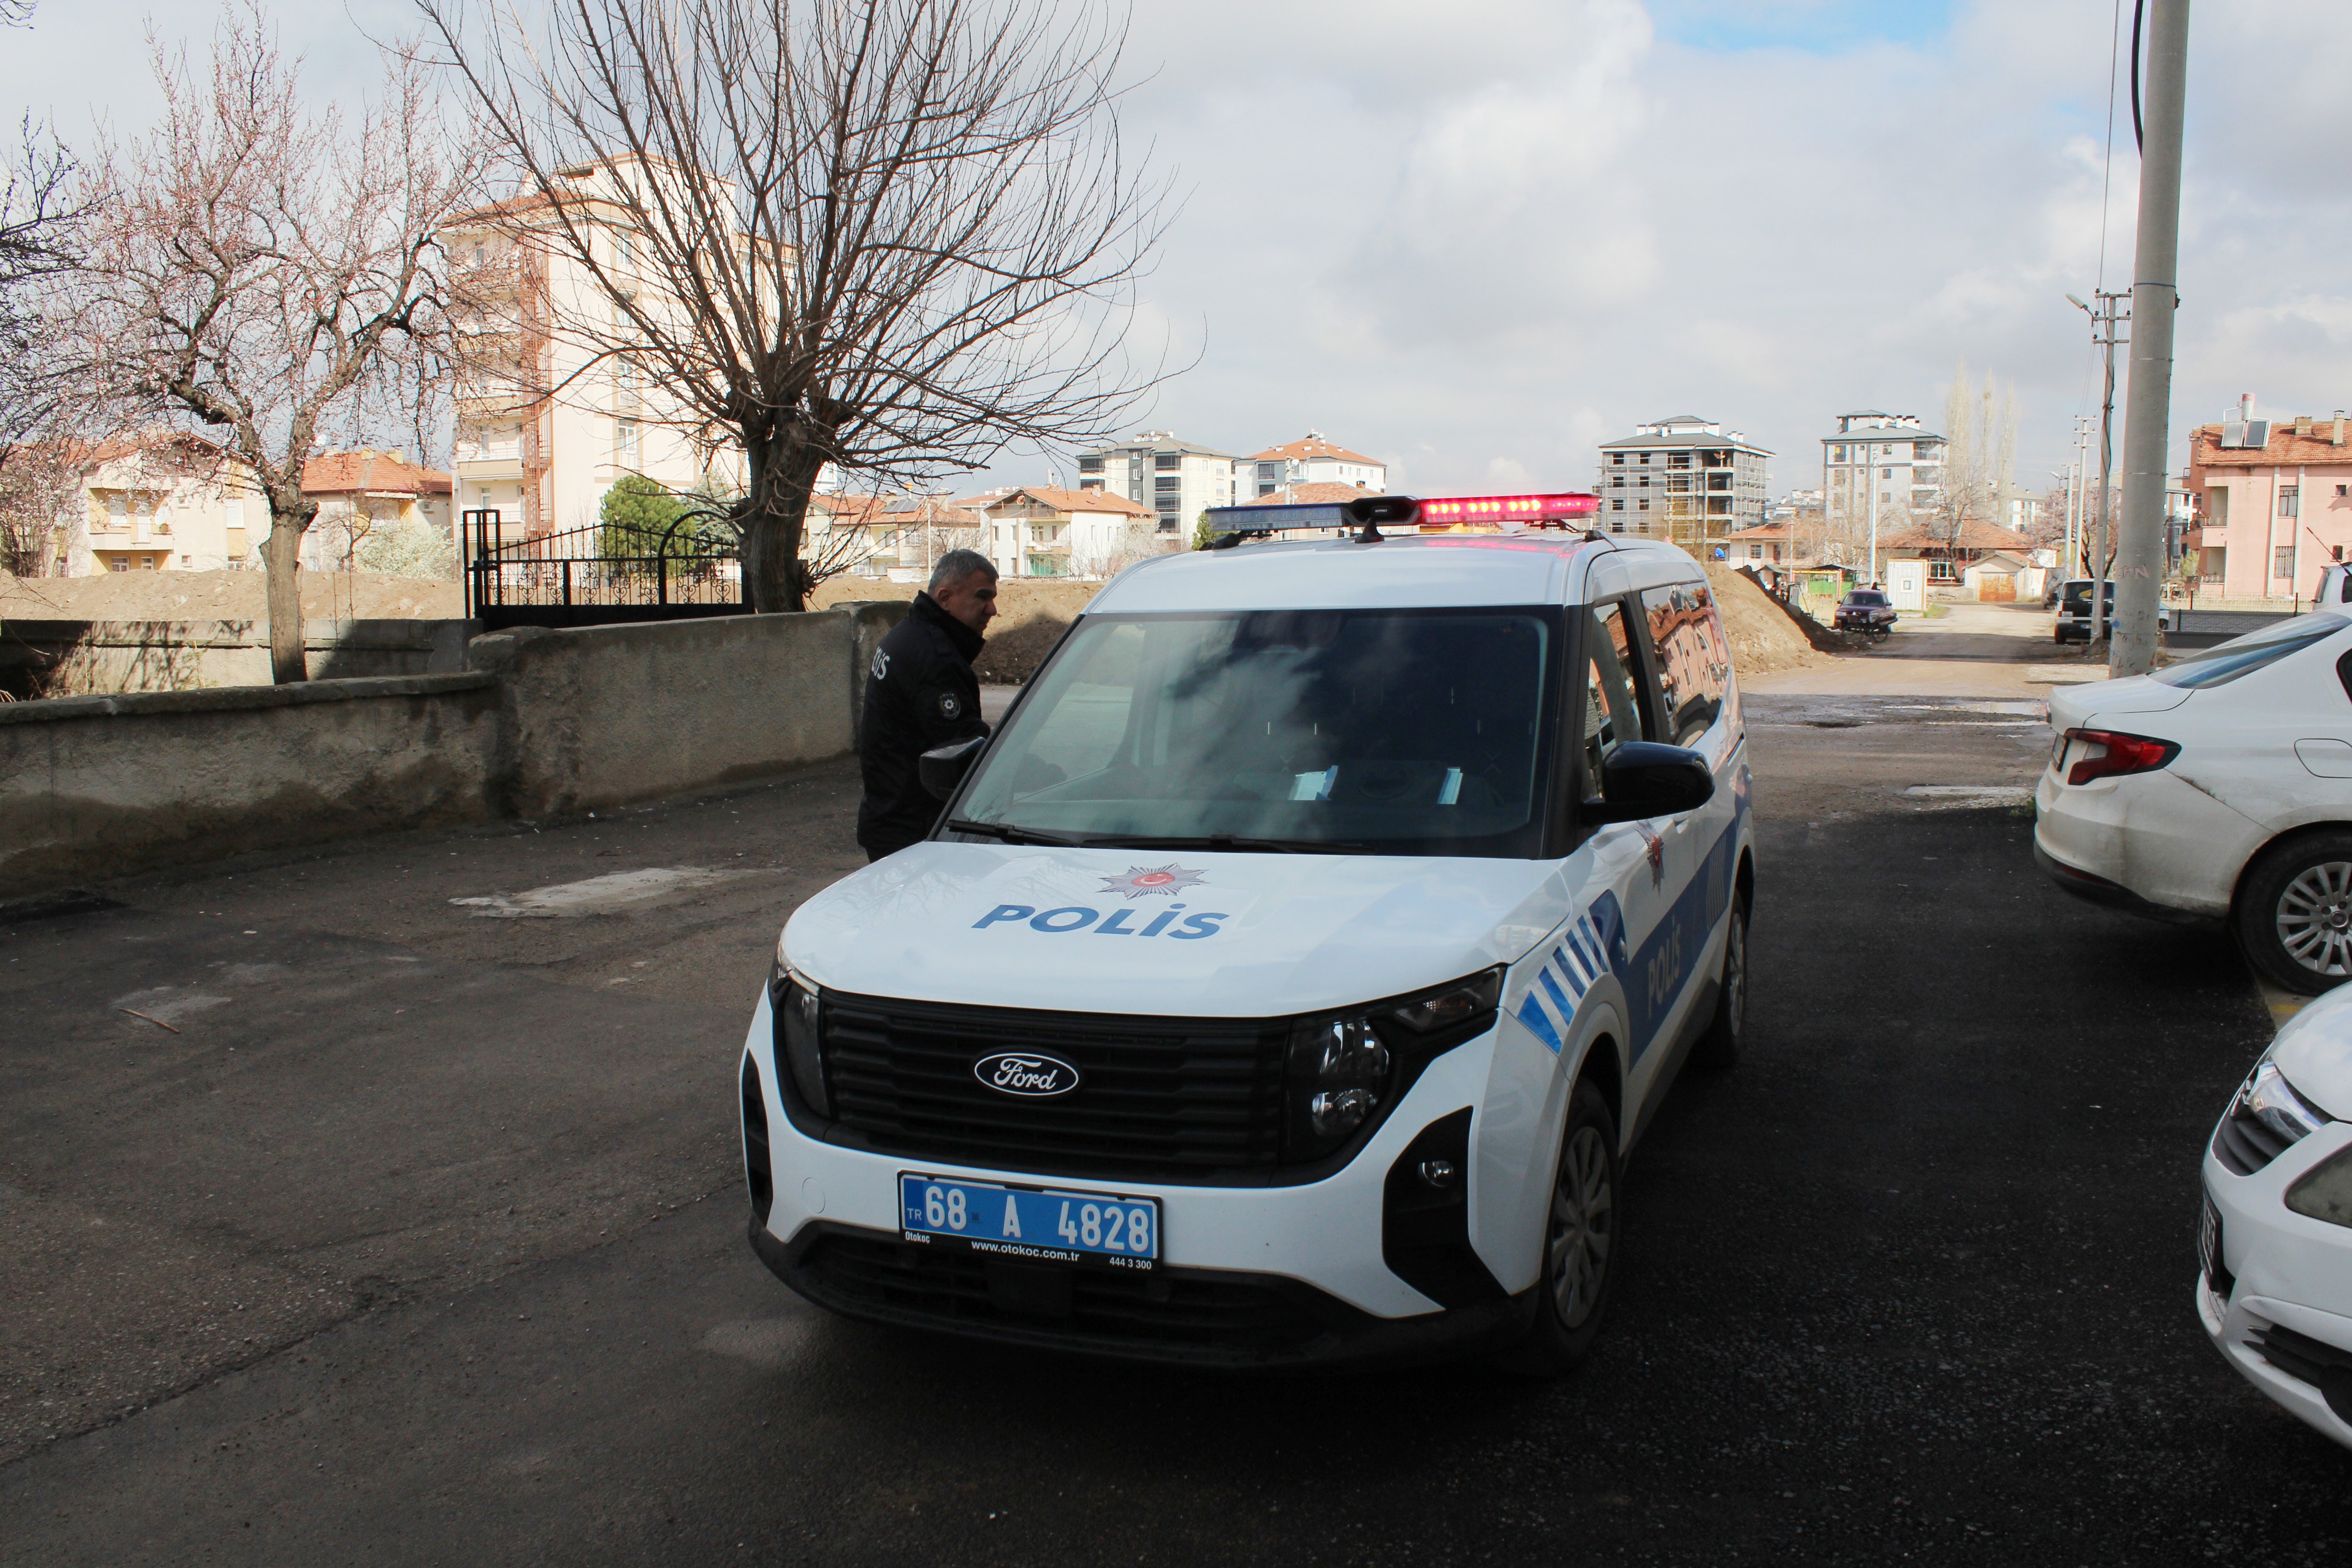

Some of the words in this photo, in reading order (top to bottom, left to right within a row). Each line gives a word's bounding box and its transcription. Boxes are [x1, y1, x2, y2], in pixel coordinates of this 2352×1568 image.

[970, 903, 1230, 940] POLİS
[994, 1058, 1057, 1089] Ford
[907, 1208, 922, 1220] TR
[926, 1186, 967, 1230] 68
[1003, 1195, 1021, 1238] A
[1058, 1200, 1149, 1253] 4828
[905, 1231, 930, 1245] Otokoç
[971, 1241, 1080, 1262] www.otokoc.com.tr
[1109, 1257, 1125, 1267] 444
[1128, 1259, 1133, 1268] 3
[1136, 1260, 1152, 1269] 300
